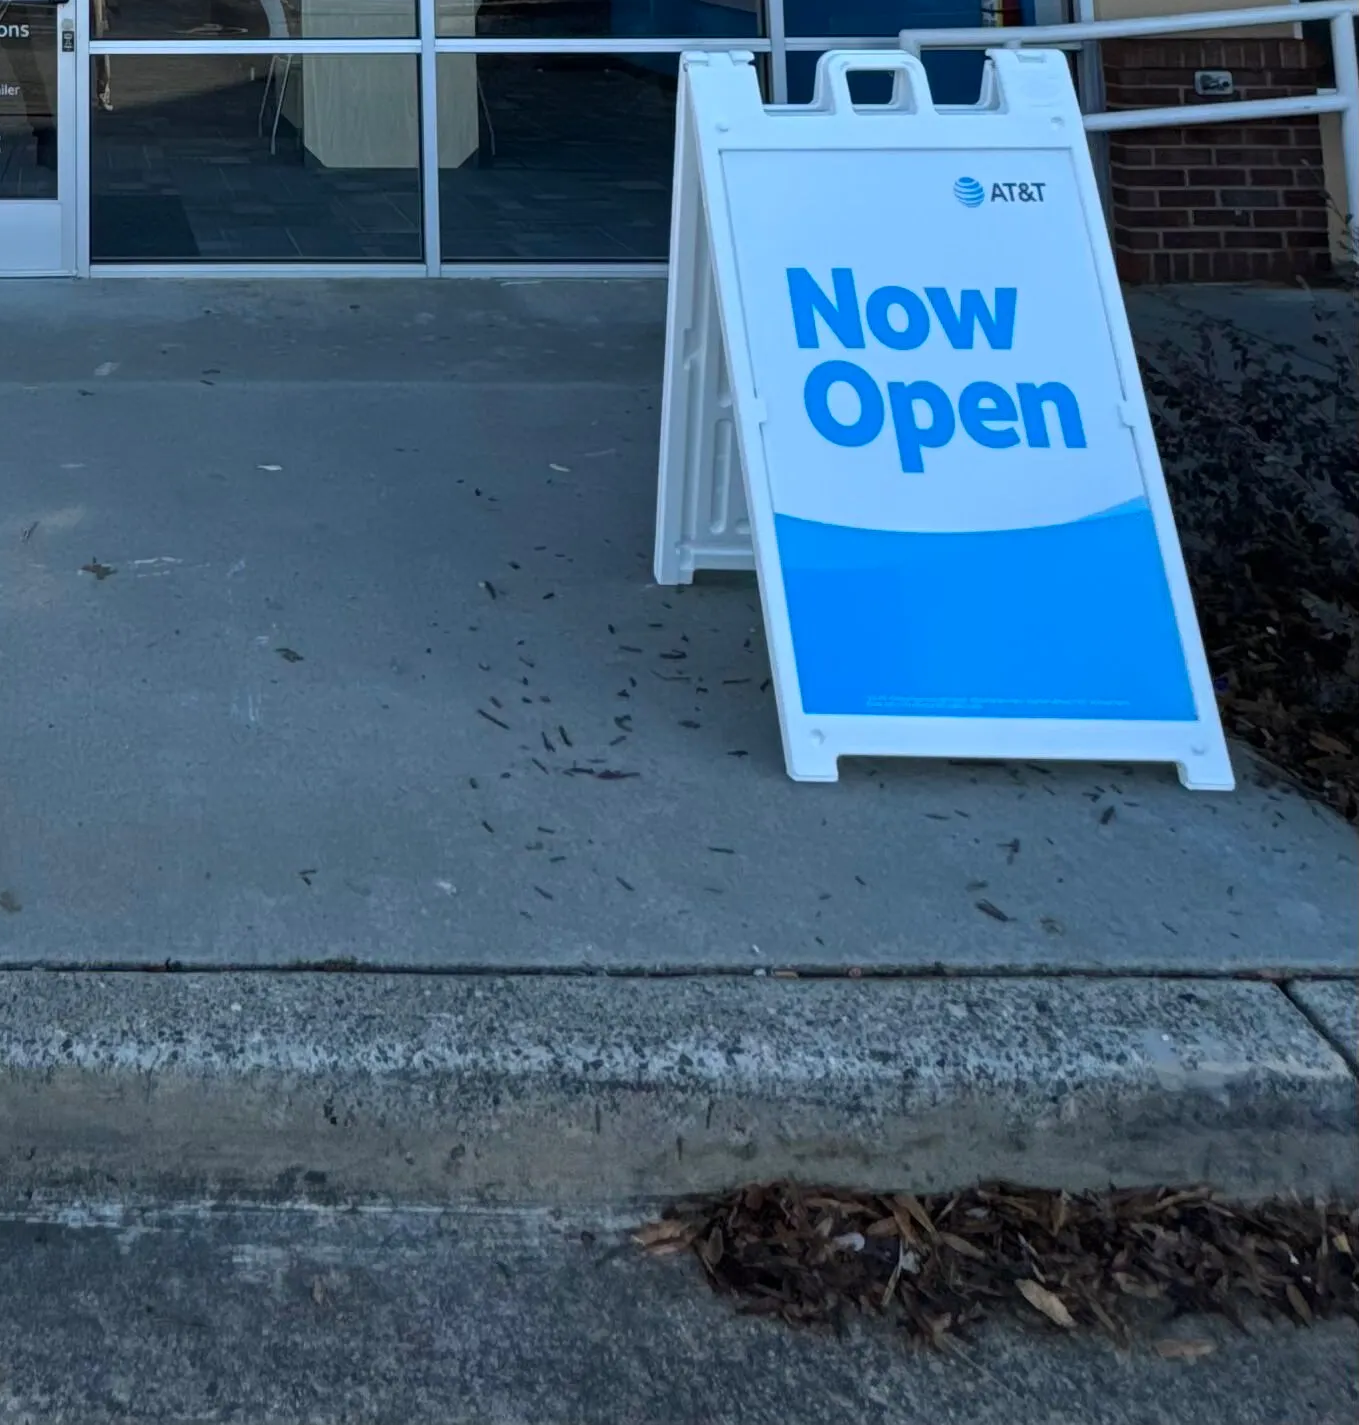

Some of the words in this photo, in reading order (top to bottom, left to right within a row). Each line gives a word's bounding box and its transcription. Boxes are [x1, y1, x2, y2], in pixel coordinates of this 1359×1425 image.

[990, 182, 1046, 203] AT&T
[786, 267, 1018, 351] Now
[803, 359, 1088, 474] Open
